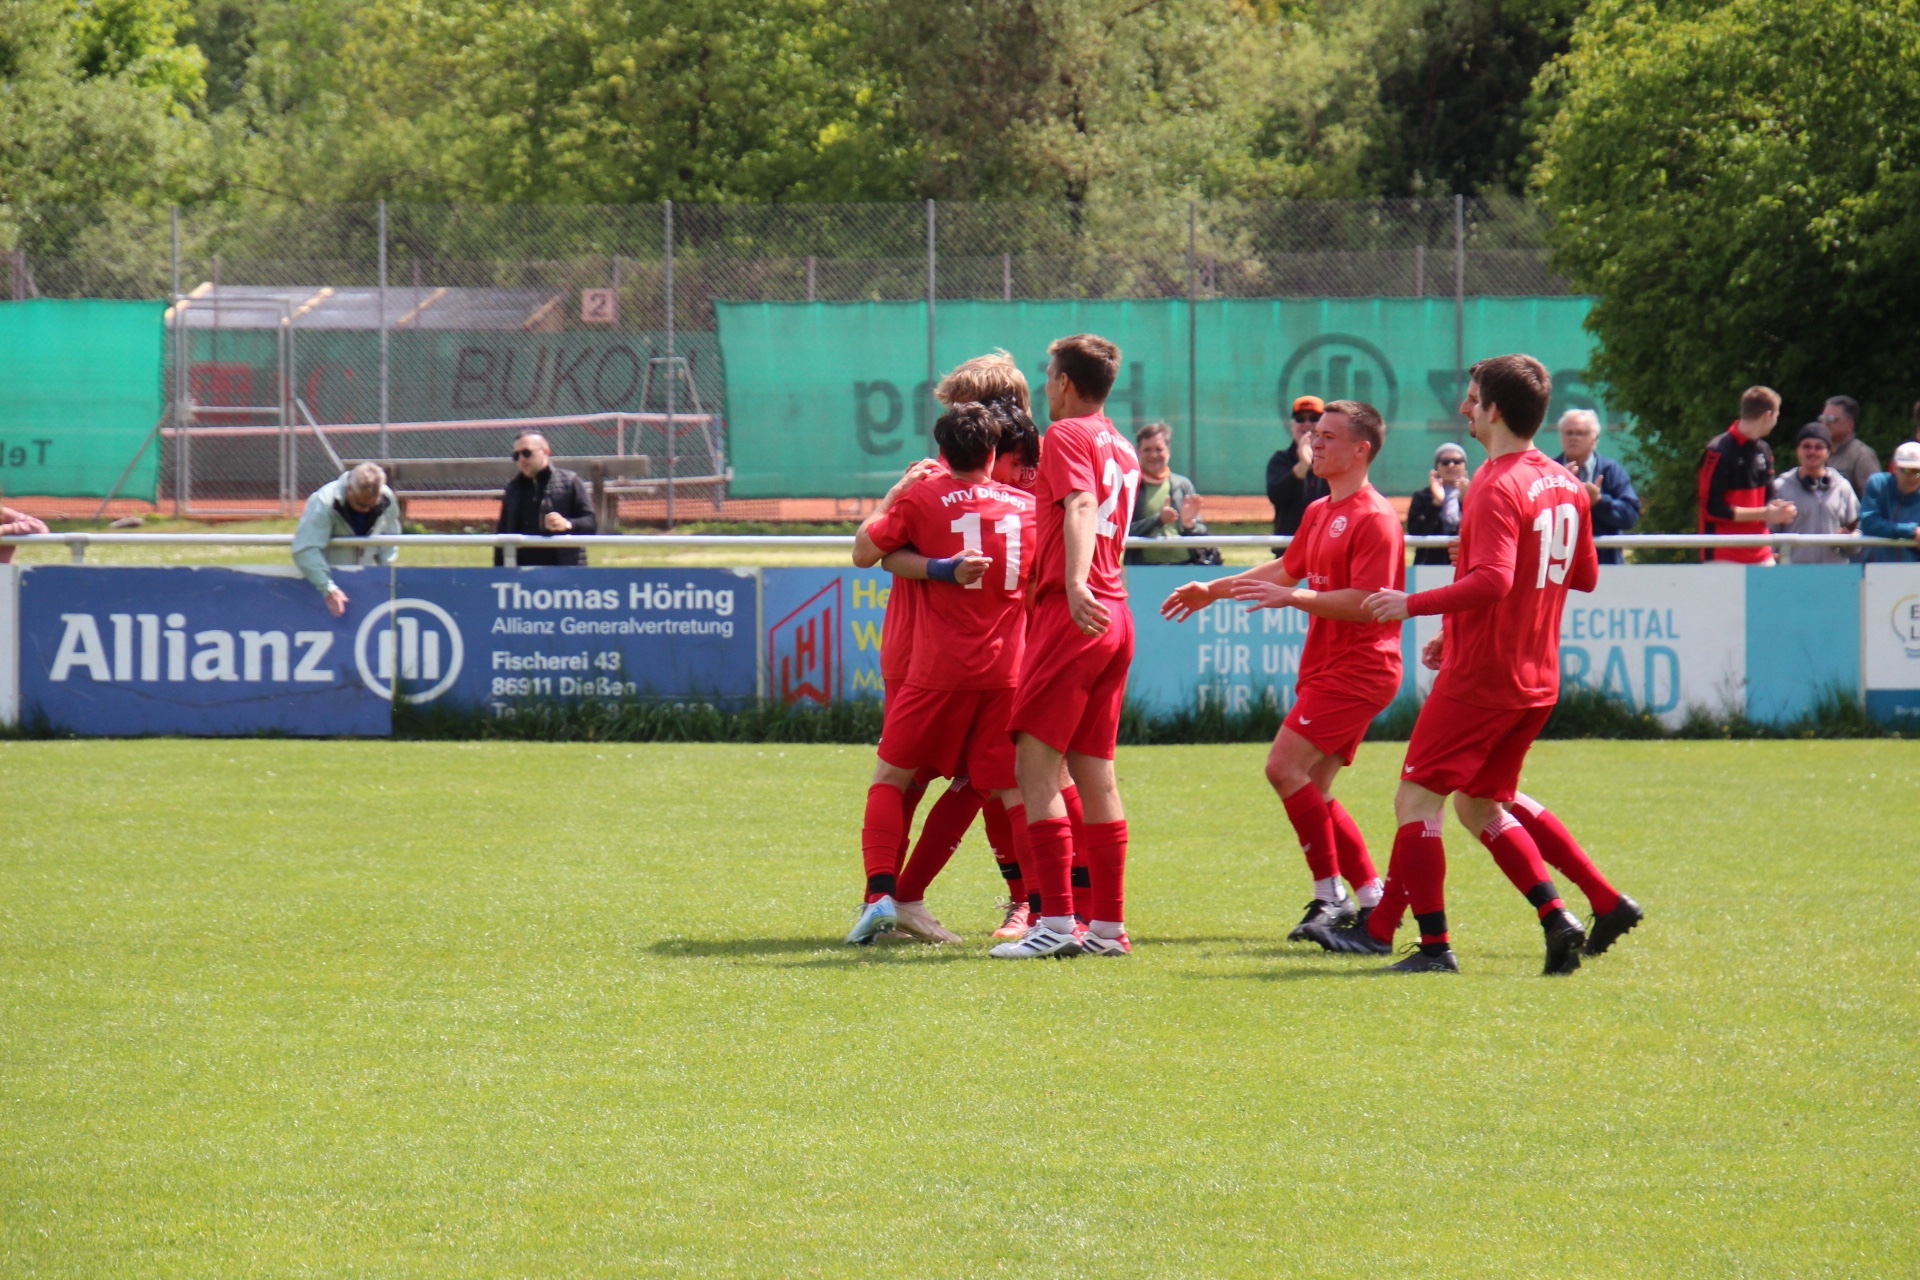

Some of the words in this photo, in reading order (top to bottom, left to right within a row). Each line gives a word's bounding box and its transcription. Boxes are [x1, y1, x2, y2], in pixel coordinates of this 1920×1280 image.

[590, 292, 608, 318] 2
[941, 488, 973, 507] MTV
[1095, 457, 1140, 546] 21
[950, 512, 1022, 591] 11
[1532, 503, 1580, 589] 19
[491, 582, 620, 610] Thomas
[629, 582, 735, 616] Höring
[491, 617, 554, 635] Allianz
[560, 617, 734, 638] Generalvertretung
[1198, 599, 1251, 634] FÜR
[49, 613, 335, 682] Allianz
[491, 651, 590, 671] Fischerei
[593, 651, 621, 671] 43
[1198, 638, 1251, 675] FÜR
[491, 676, 552, 696] 86911
[1198, 680, 1251, 714] FÜR
